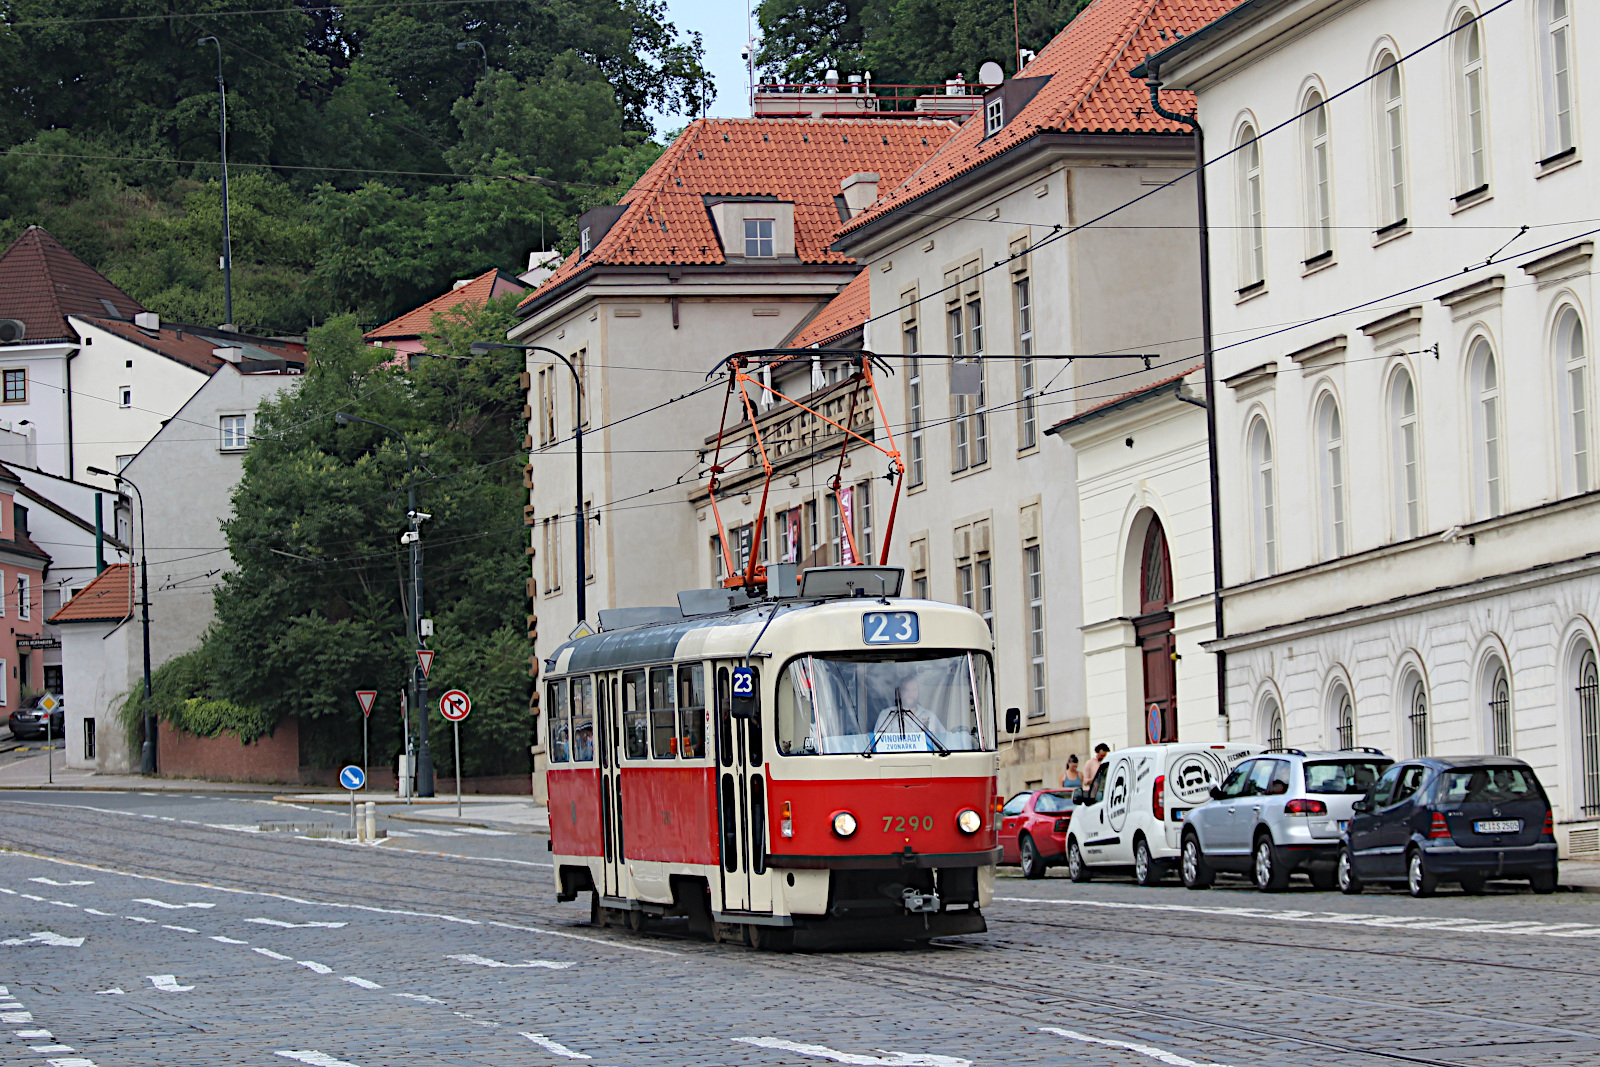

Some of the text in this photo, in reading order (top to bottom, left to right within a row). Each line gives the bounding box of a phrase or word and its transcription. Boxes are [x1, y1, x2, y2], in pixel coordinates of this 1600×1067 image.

[869, 613, 912, 641] 23
[733, 673, 752, 693] 23
[882, 815, 934, 832] 7290
